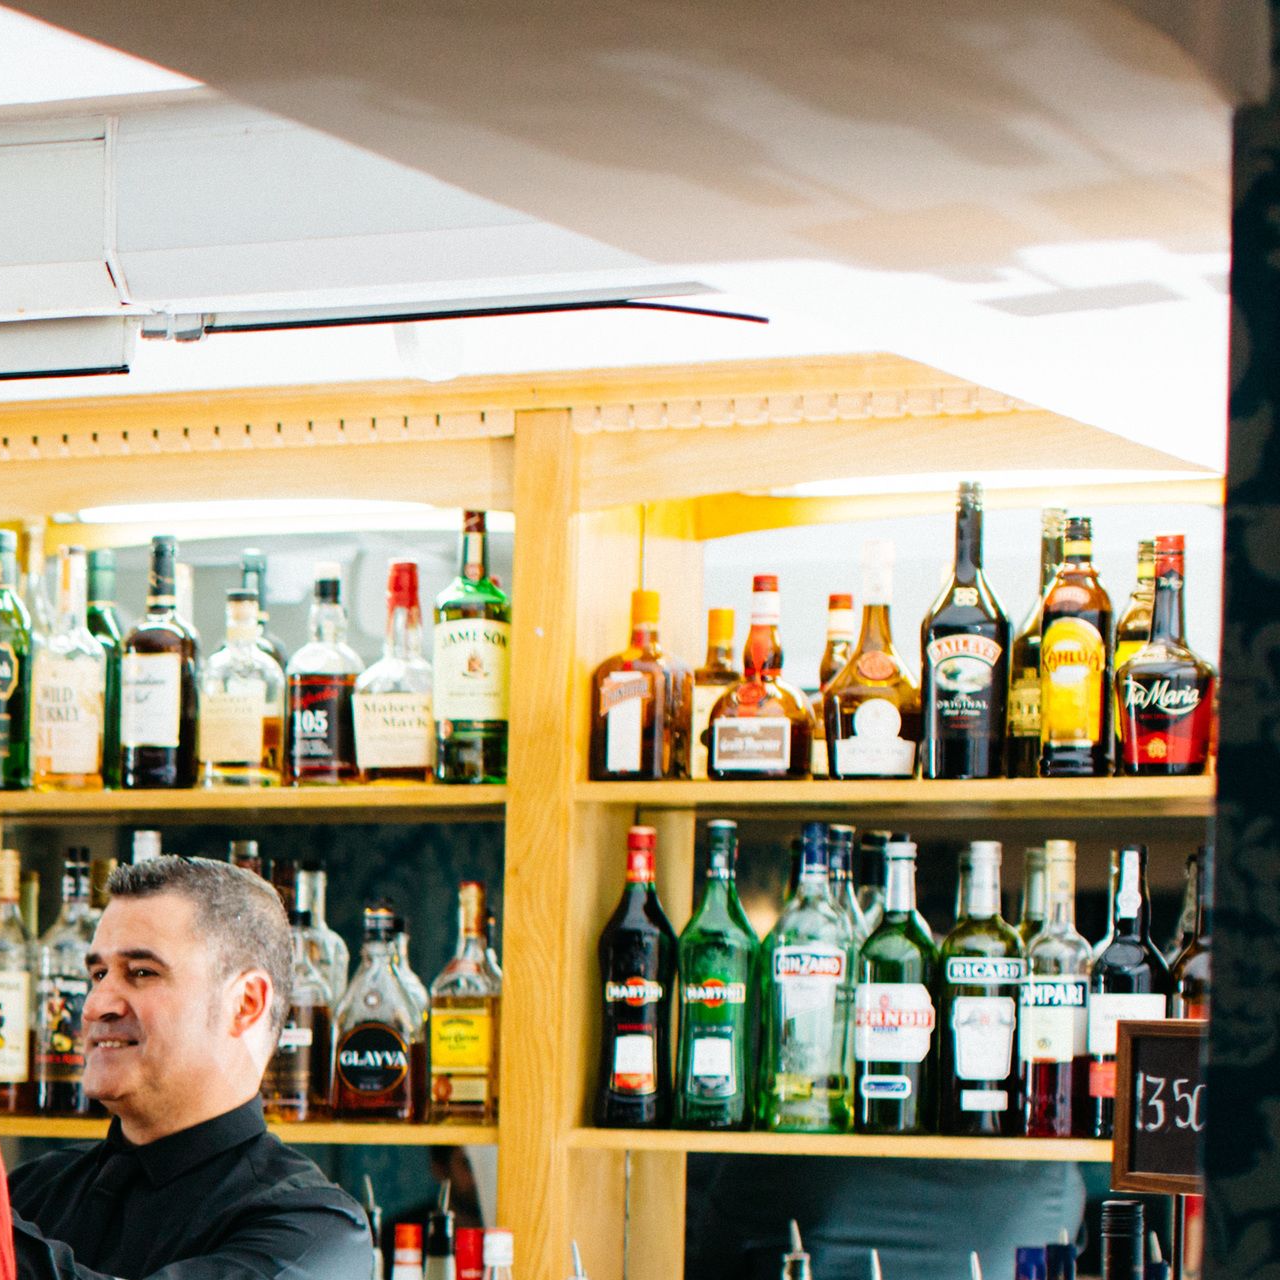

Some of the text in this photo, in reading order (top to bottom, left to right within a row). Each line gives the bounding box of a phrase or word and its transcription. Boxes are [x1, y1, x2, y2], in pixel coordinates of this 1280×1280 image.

[443, 629, 507, 649] JAMESON
[1142, 679, 1201, 714] Maria
[294, 710, 328, 733] 105
[951, 961, 1020, 979] RICARD
[608, 984, 662, 1000] MARTINI
[686, 985, 742, 1000] MARTINI
[340, 1050, 408, 1067] GLAYVA
